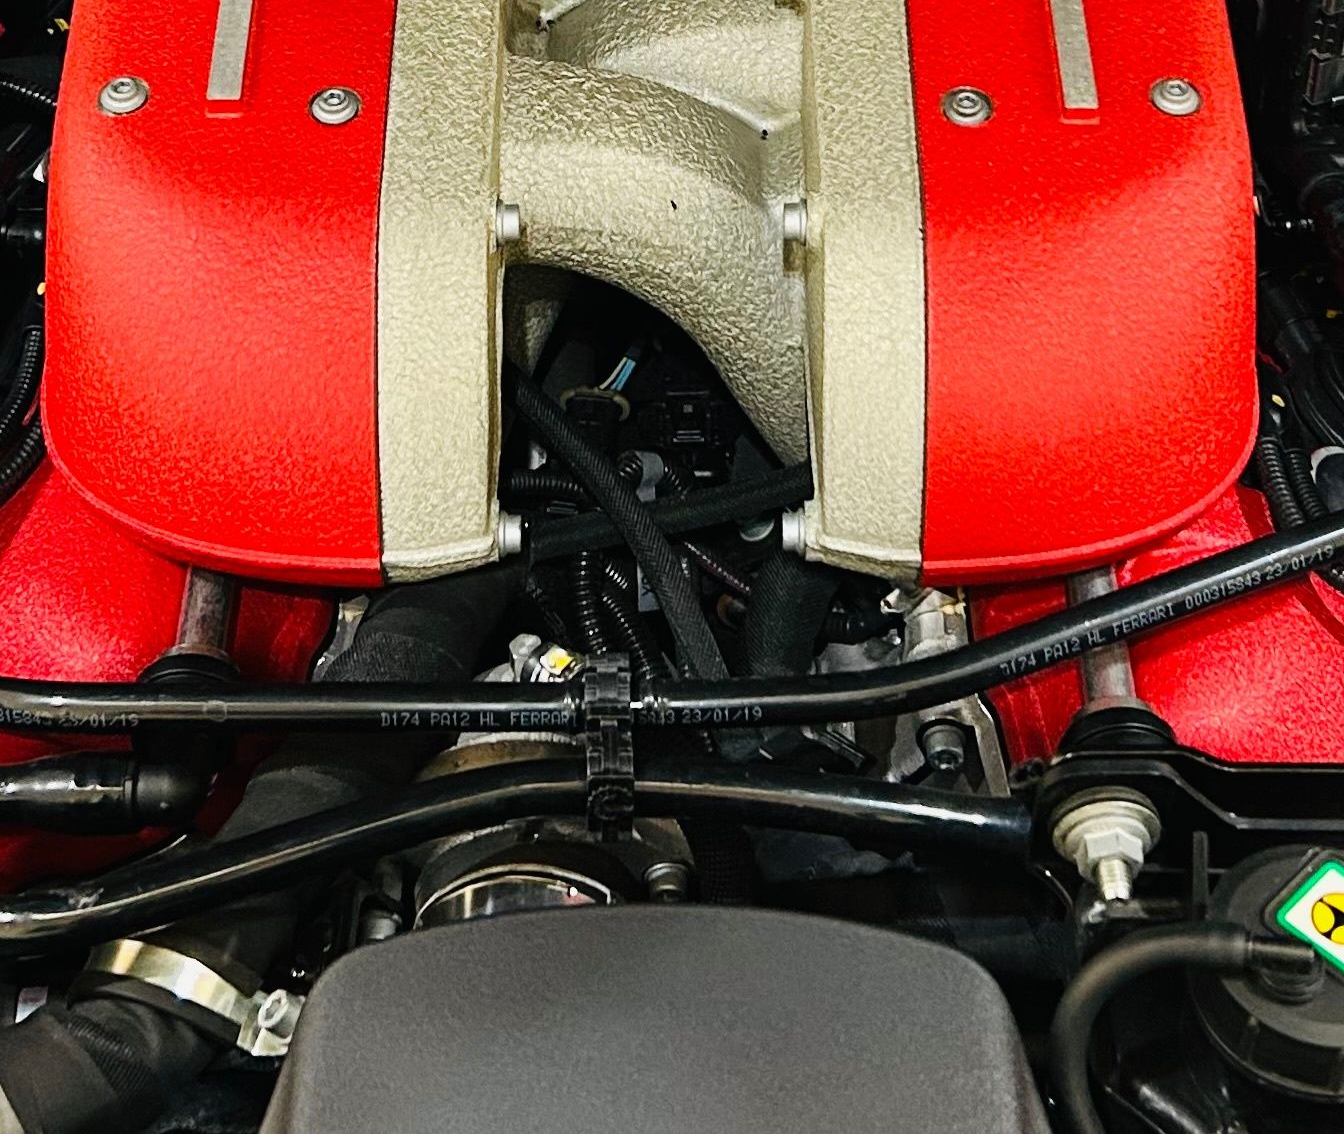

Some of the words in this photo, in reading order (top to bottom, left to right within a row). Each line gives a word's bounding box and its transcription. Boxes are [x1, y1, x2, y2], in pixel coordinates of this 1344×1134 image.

[1043, 638, 1081, 663] PA12
[1087, 629, 1107, 648] HL
[1112, 603, 1175, 638] FERRARI
[1264, 545, 1335, 583] 23/01/19
[380, 711, 420, 727] D174
[430, 711, 471, 726] PA12
[479, 712, 501, 727] HL
[681, 708, 763, 724] 23/01/19
